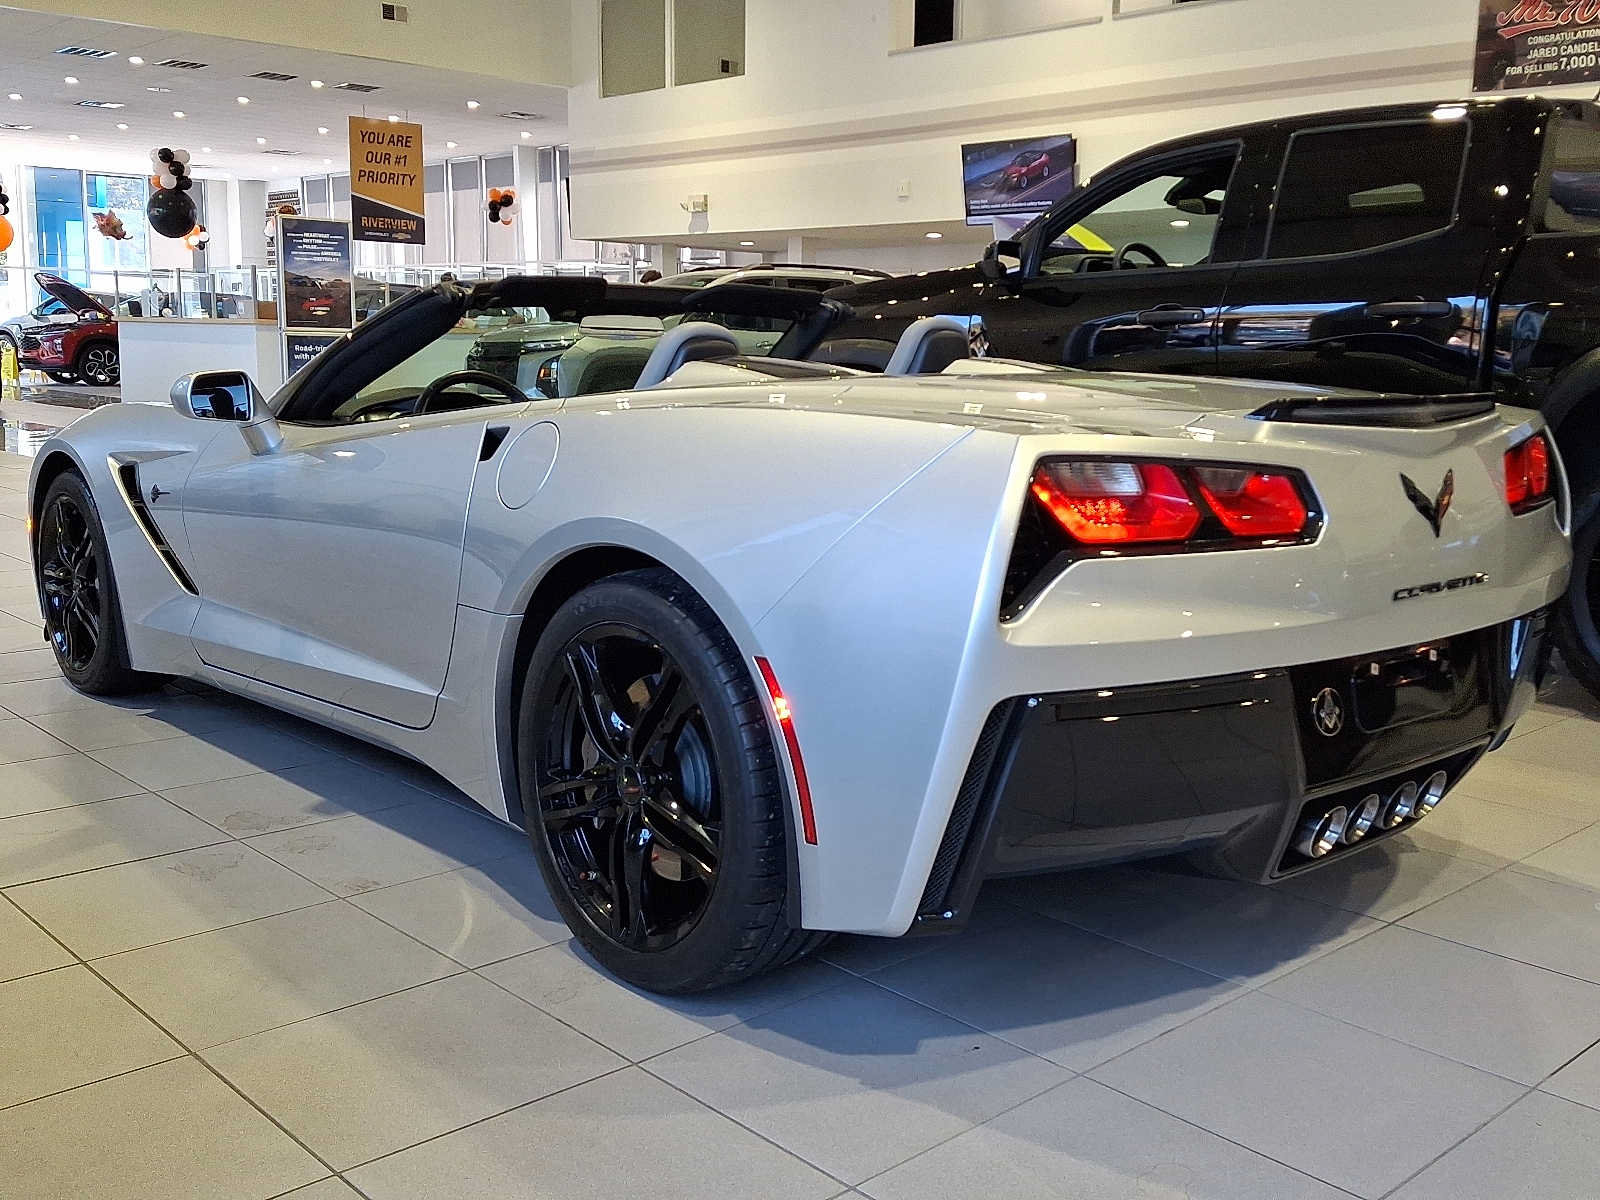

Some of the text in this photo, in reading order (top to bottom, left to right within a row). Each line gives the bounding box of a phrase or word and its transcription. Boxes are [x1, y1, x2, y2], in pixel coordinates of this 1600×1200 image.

[1526, 46, 1559, 60] JARED
[1505, 66, 1524, 76] FOR
[1524, 62, 1559, 74] SELLING
[1559, 54, 1596, 72] 7,000
[360, 130, 413, 148] YOU ARE
[365, 150, 408, 168] OUR #1
[357, 169, 417, 187] PRIORITY
[361, 216, 417, 231] RIVERVIEW
